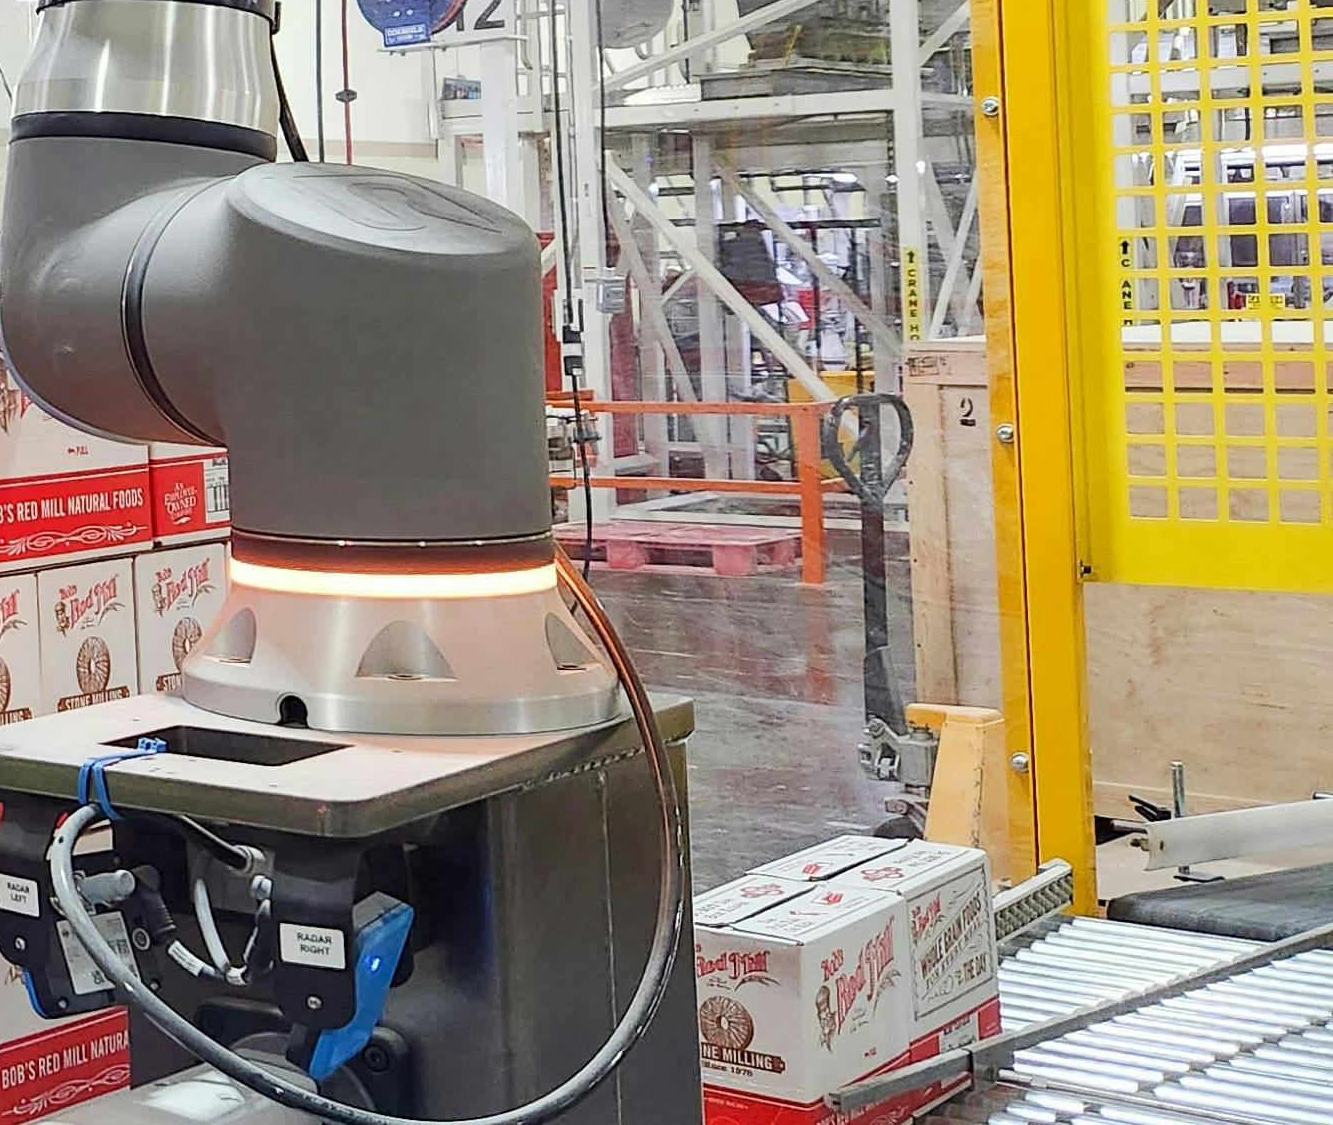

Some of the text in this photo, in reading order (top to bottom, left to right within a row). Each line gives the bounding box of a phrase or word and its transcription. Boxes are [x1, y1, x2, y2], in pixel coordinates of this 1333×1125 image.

[16, 500, 39, 522] RED
[41, 497, 65, 519] MILL
[67, 491, 111, 516] NATURAL
[112, 487, 144, 510] FOODS
[7, 882, 30, 894] RADAR
[10, 893, 27, 904] LEFT
[297, 932, 332, 945] RADAR
[300, 945, 330, 955] RIGHT
[1, 1030, 129, 1090] BOB'S RED MILL NATURA
[722, 1049, 773, 1069] MILLING
